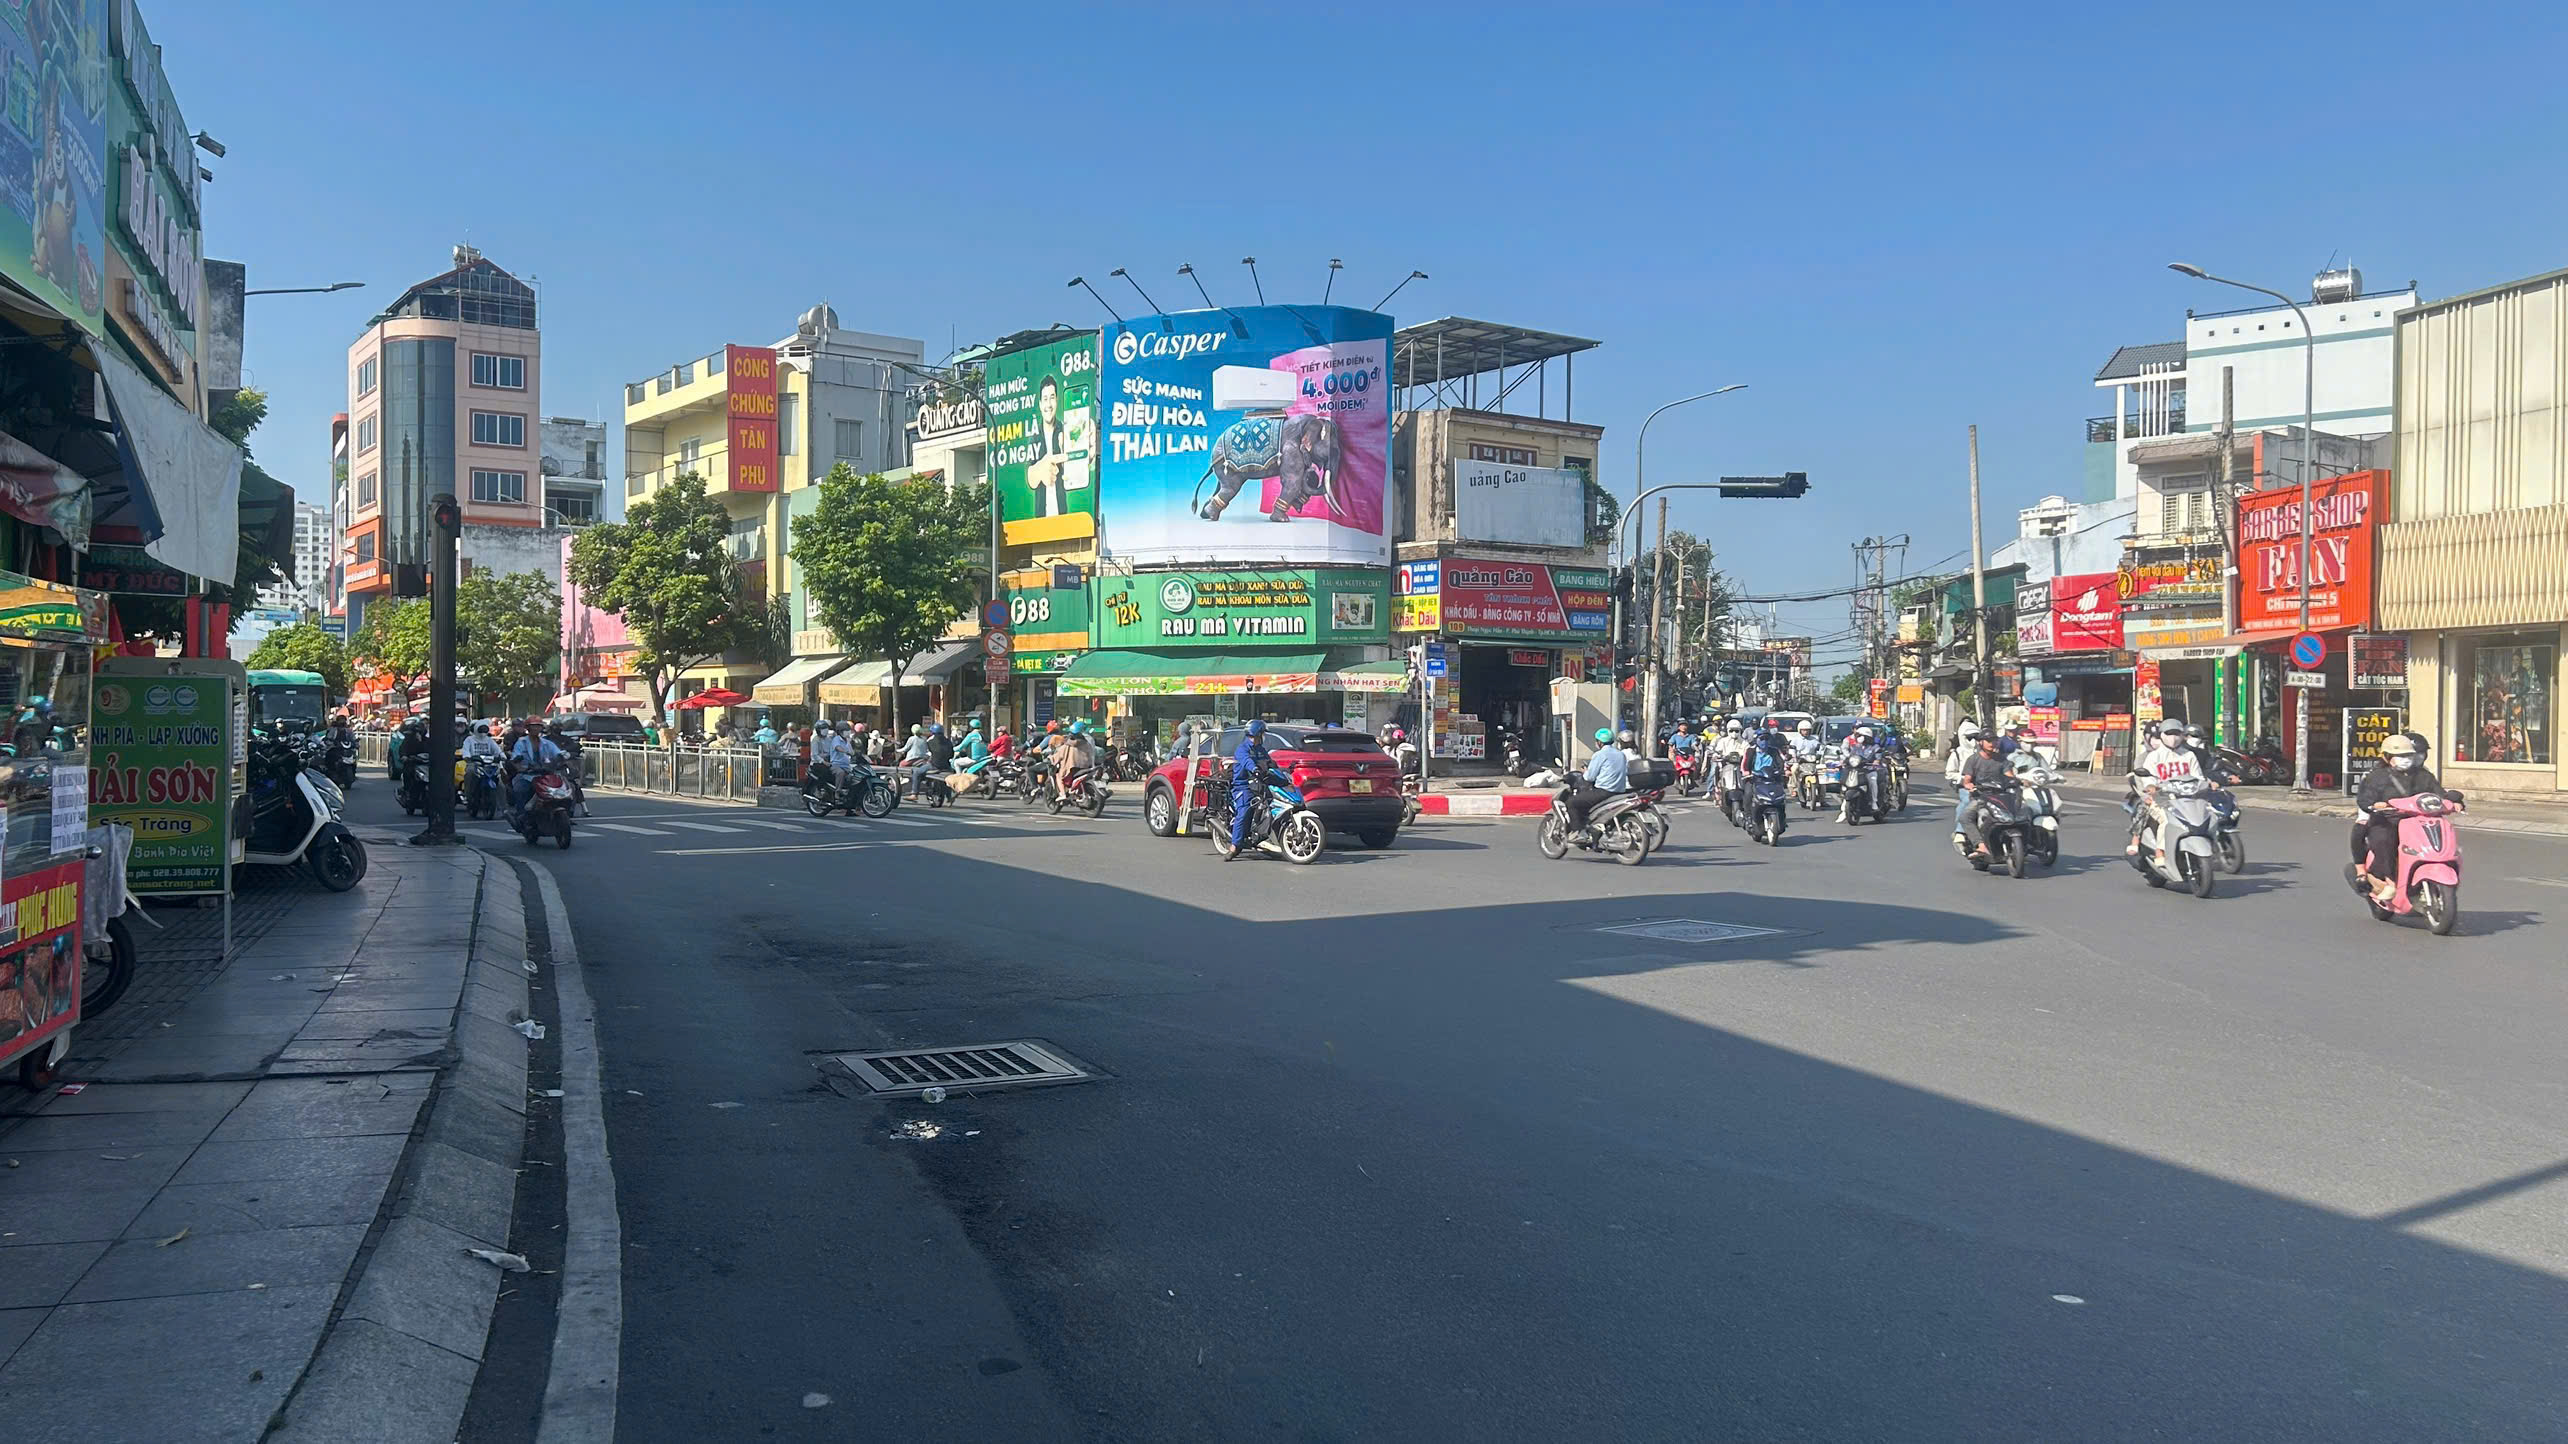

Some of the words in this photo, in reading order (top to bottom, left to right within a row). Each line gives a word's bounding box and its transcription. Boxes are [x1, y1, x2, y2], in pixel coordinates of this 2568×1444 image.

[1139, 331, 1227, 361] Casper
[734, 353, 770, 379] CÔNG
[988, 382, 1008, 401] HẠN
[1008, 375, 1028, 393] MỨC
[1122, 376, 1152, 397] SỨC
[1155, 382, 1202, 401] MẠNH
[730, 388, 774, 414] CHỨNG
[989, 399, 1019, 416] TRONG
[1020, 393, 1037, 410] TAY
[1111, 394, 1159, 427] ĐIỀU
[1162, 403, 1208, 427] HÒA
[740, 424, 766, 449] TÂN
[1024, 413, 1040, 438] LÀ
[1009, 442, 1042, 465] NGAY
[1109, 425, 1161, 463] THÁI
[1166, 432, 1209, 455] LAN
[739, 461, 766, 485] PHÚ
[1469, 470, 1500, 489] uảng
[1504, 470, 1527, 484] Cao
[2315, 491, 2368, 530] SHOP
[2256, 535, 2350, 592] FAN
[1448, 566, 1501, 589] Quảng
[1504, 567, 1534, 584] Cáo
[2286, 593, 2327, 610] NHNH
[2328, 592, 2338, 606] 5
[1161, 618, 1195, 636] RAU
[1200, 612, 1229, 636] MÁ
[1233, 616, 1306, 634] VITAMIN
[1503, 607, 1522, 621] CÔNG
[1536, 606, 1547, 623] SỐ
[1317, 678, 1332, 686] NG
[1383, 678, 1401, 687] SEN
[91, 726, 109, 745] NH
[175, 720, 219, 745] XƯỞNG
[2356, 712, 2391, 728] CẮT
[147, 759, 217, 804] SƠN
[139, 816, 192, 833] Trăng
